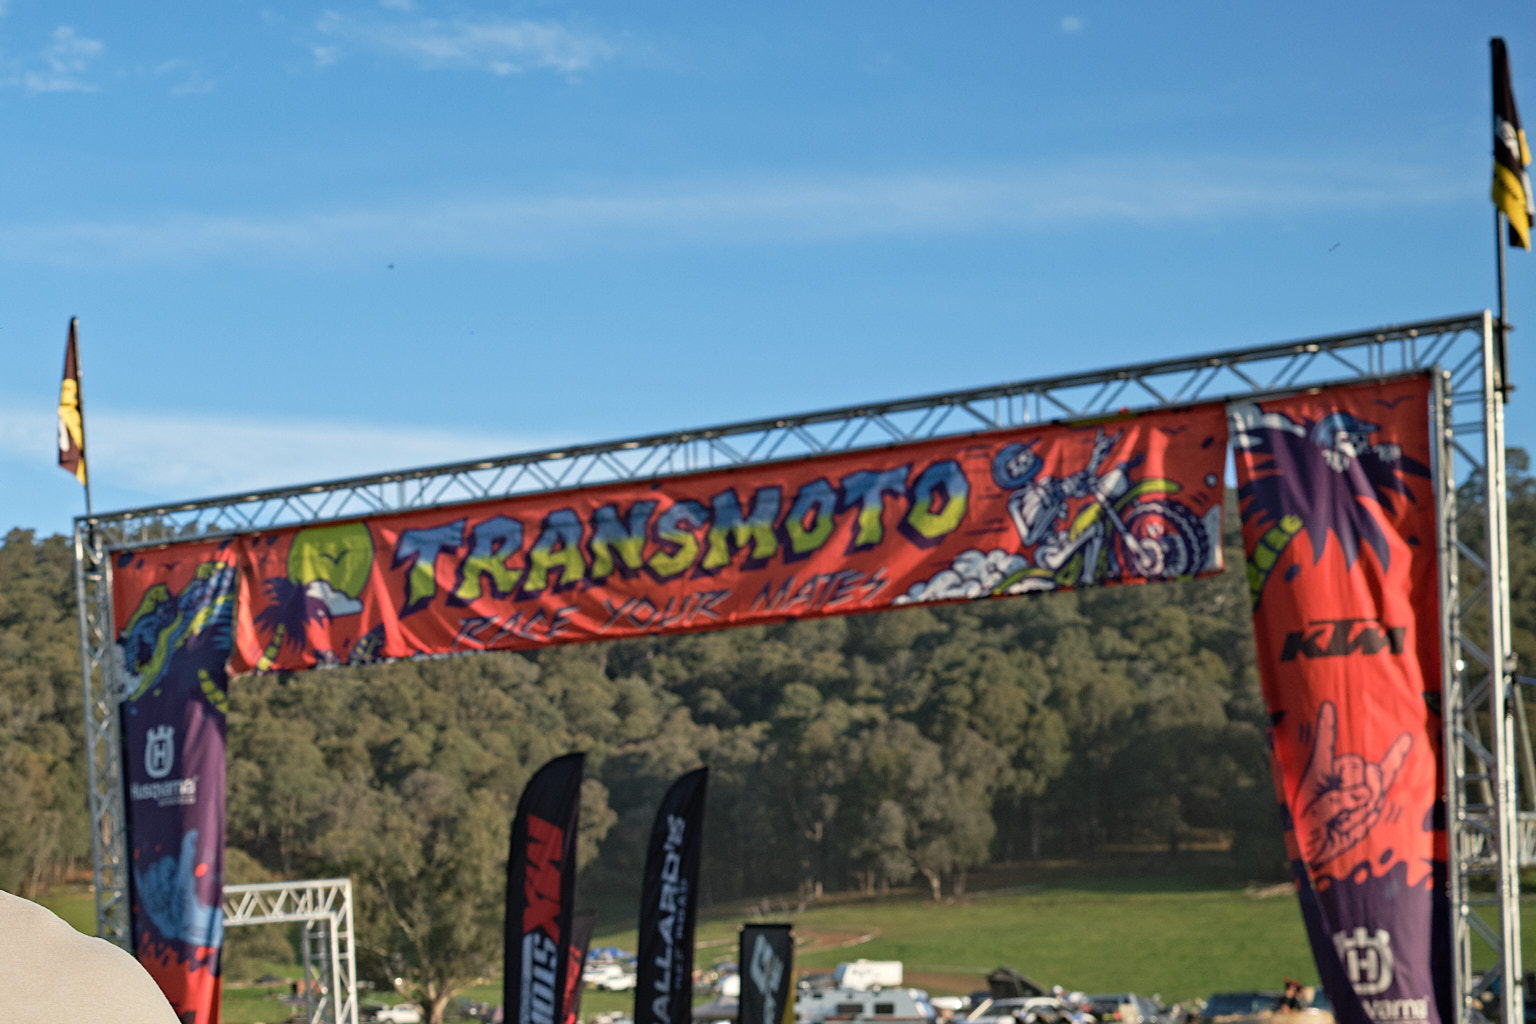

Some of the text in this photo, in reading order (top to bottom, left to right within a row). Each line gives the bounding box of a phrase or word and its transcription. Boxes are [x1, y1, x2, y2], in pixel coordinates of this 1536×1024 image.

[392, 459, 970, 608] TRANSMOTO
[452, 606, 580, 650] RACE
[600, 589, 731, 634] YOUR
[1280, 617, 1407, 663] KTM
[1362, 999, 1428, 1019] varna
